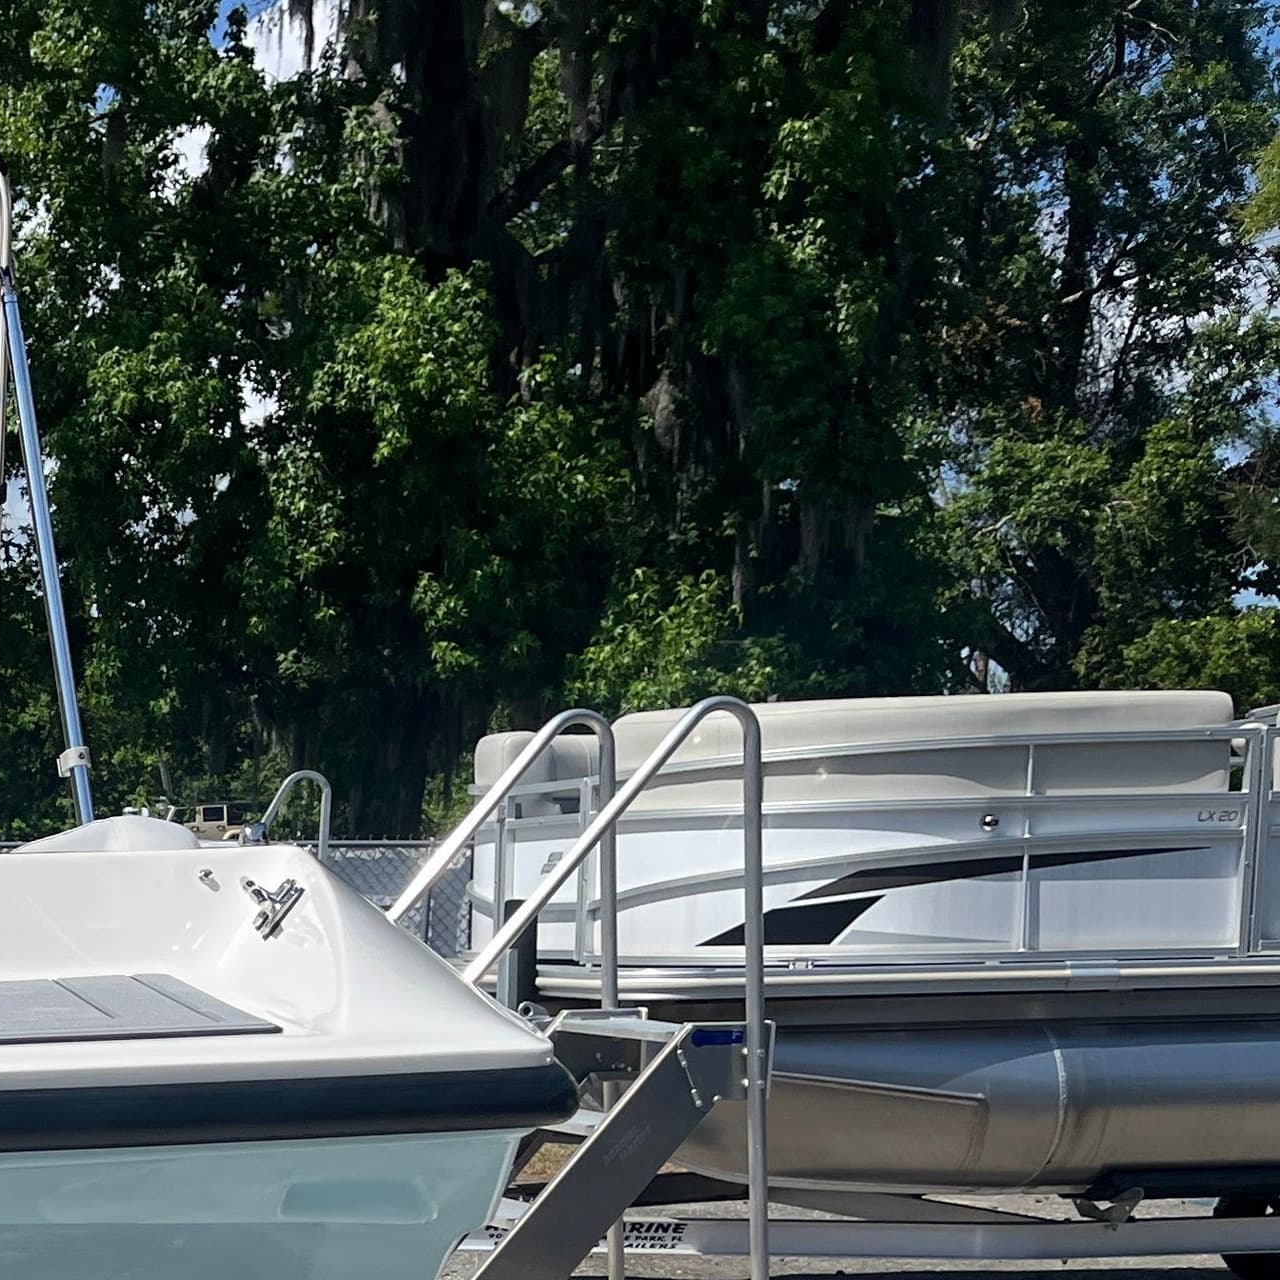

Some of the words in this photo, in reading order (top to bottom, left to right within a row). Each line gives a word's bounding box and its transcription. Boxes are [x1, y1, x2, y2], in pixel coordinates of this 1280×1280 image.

[1197, 810, 1217, 822] LX
[1218, 810, 1239, 822] 20
[623, 1223, 688, 1234] RINE
